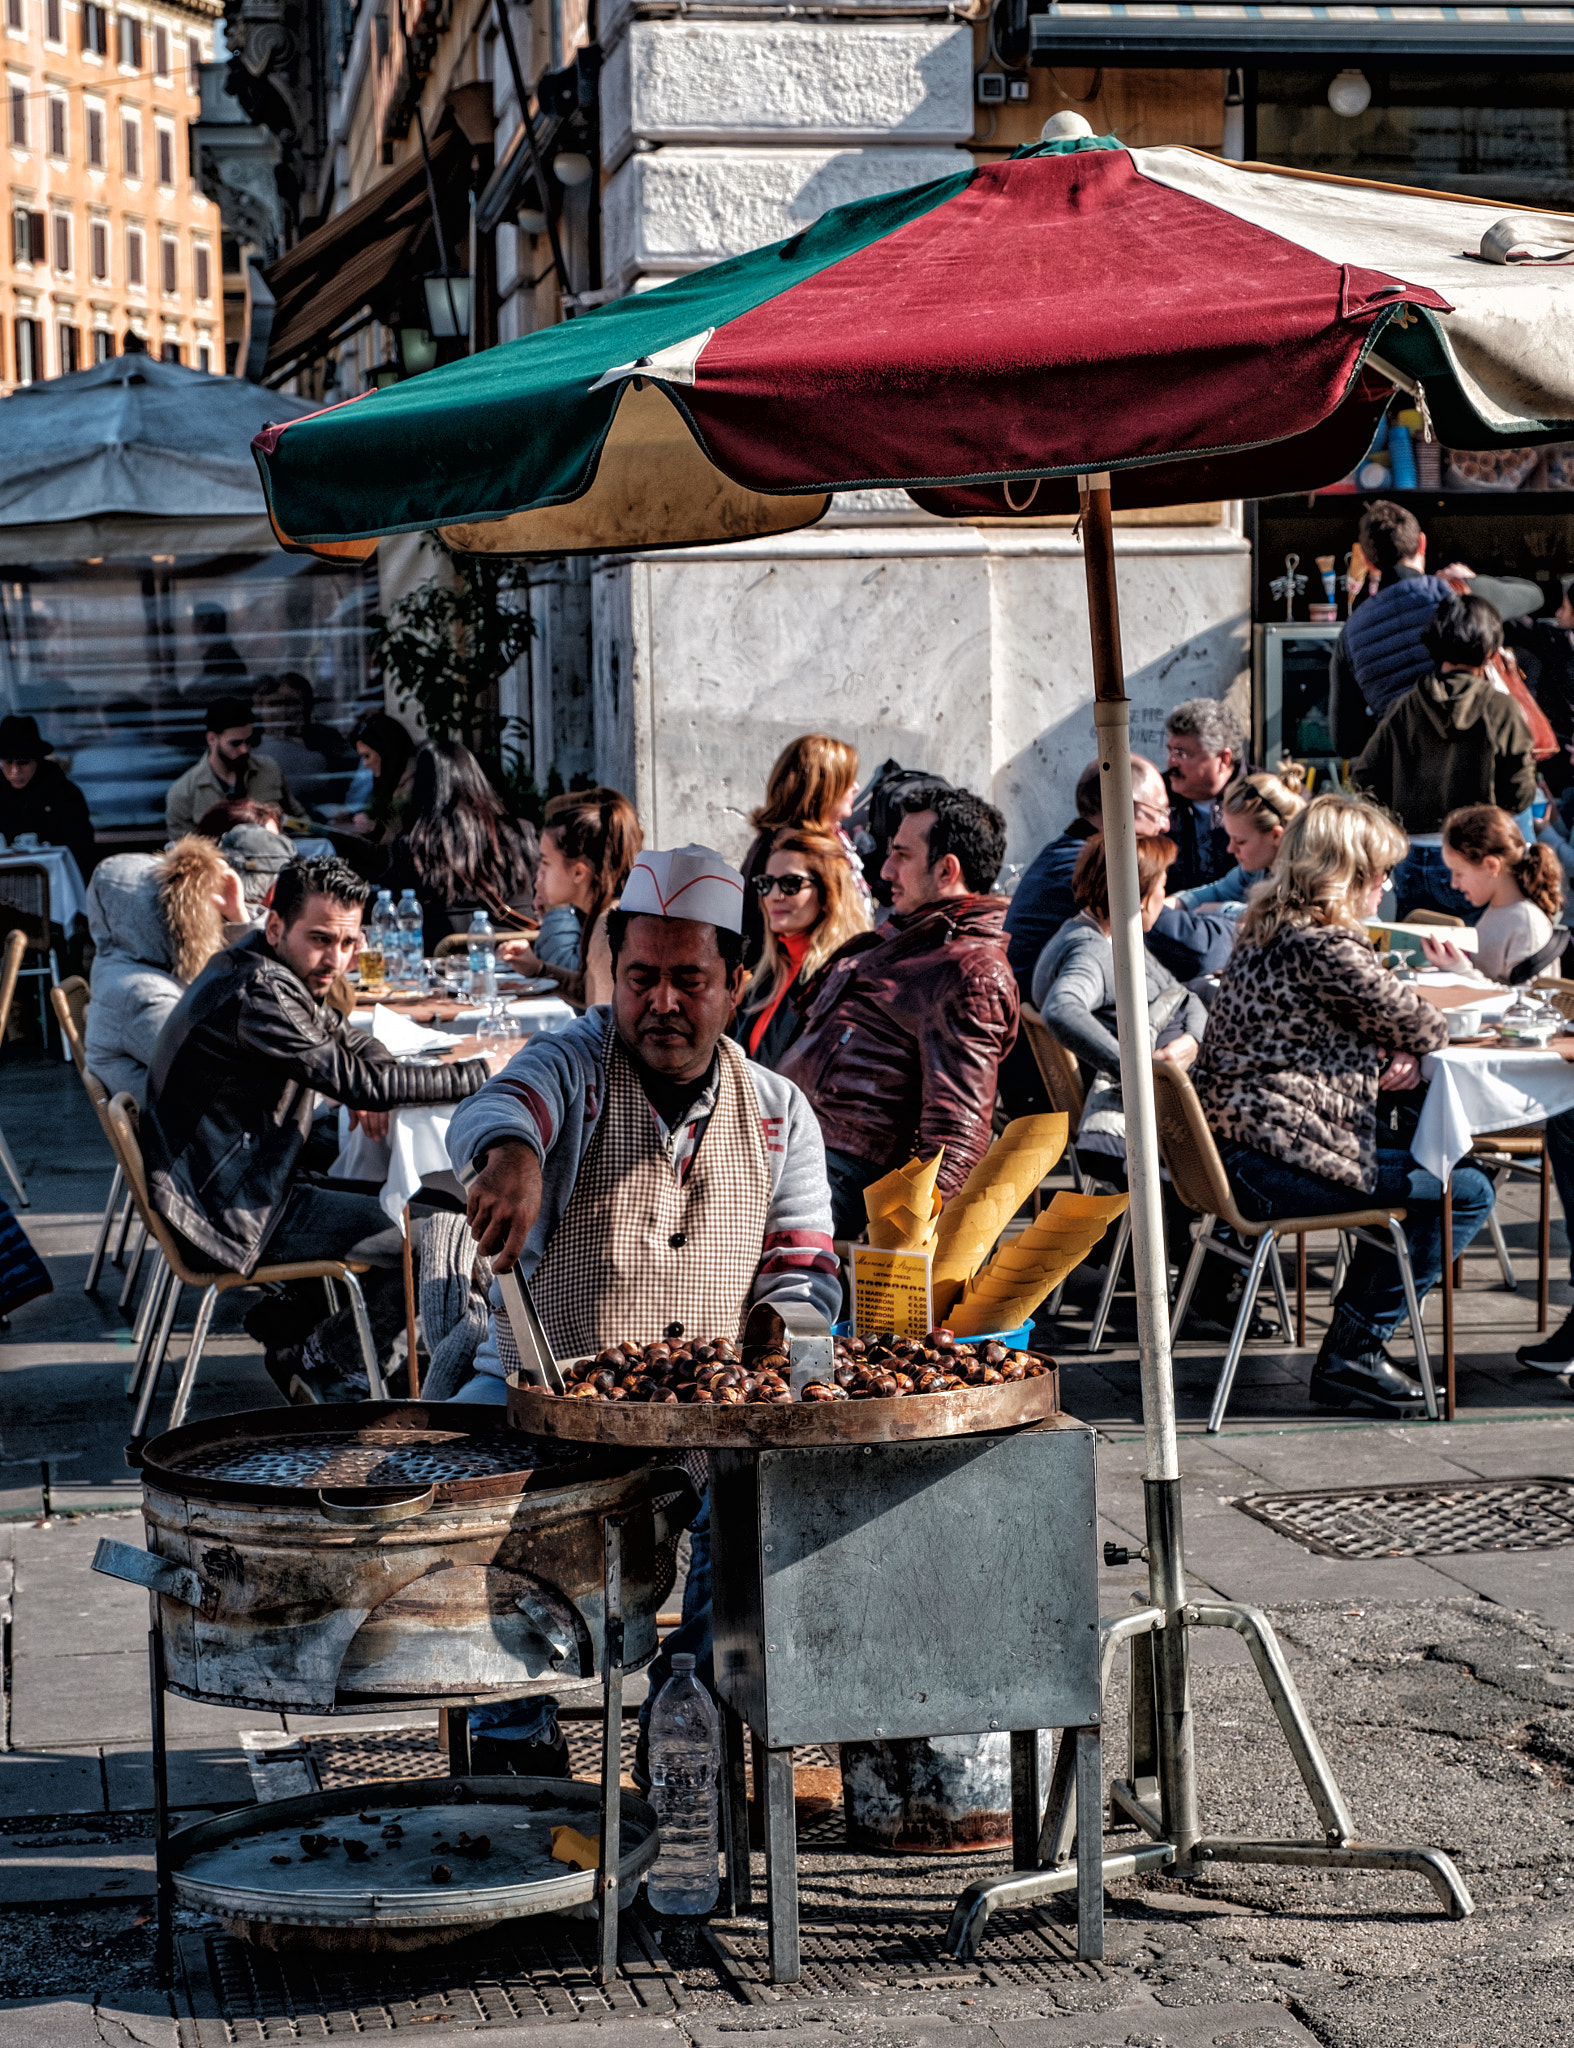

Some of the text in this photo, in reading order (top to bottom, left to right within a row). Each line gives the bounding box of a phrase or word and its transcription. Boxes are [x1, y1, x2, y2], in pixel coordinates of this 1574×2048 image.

[865, 1290, 895, 1298] MARRONI
[865, 1297, 895, 1305] MARRONI
[865, 1304, 895, 1312] MARRONI
[865, 1310, 895, 1318] MARRONI
[865, 1317, 895, 1325] MARRONI
[865, 1324, 895, 1332] MARRONI
